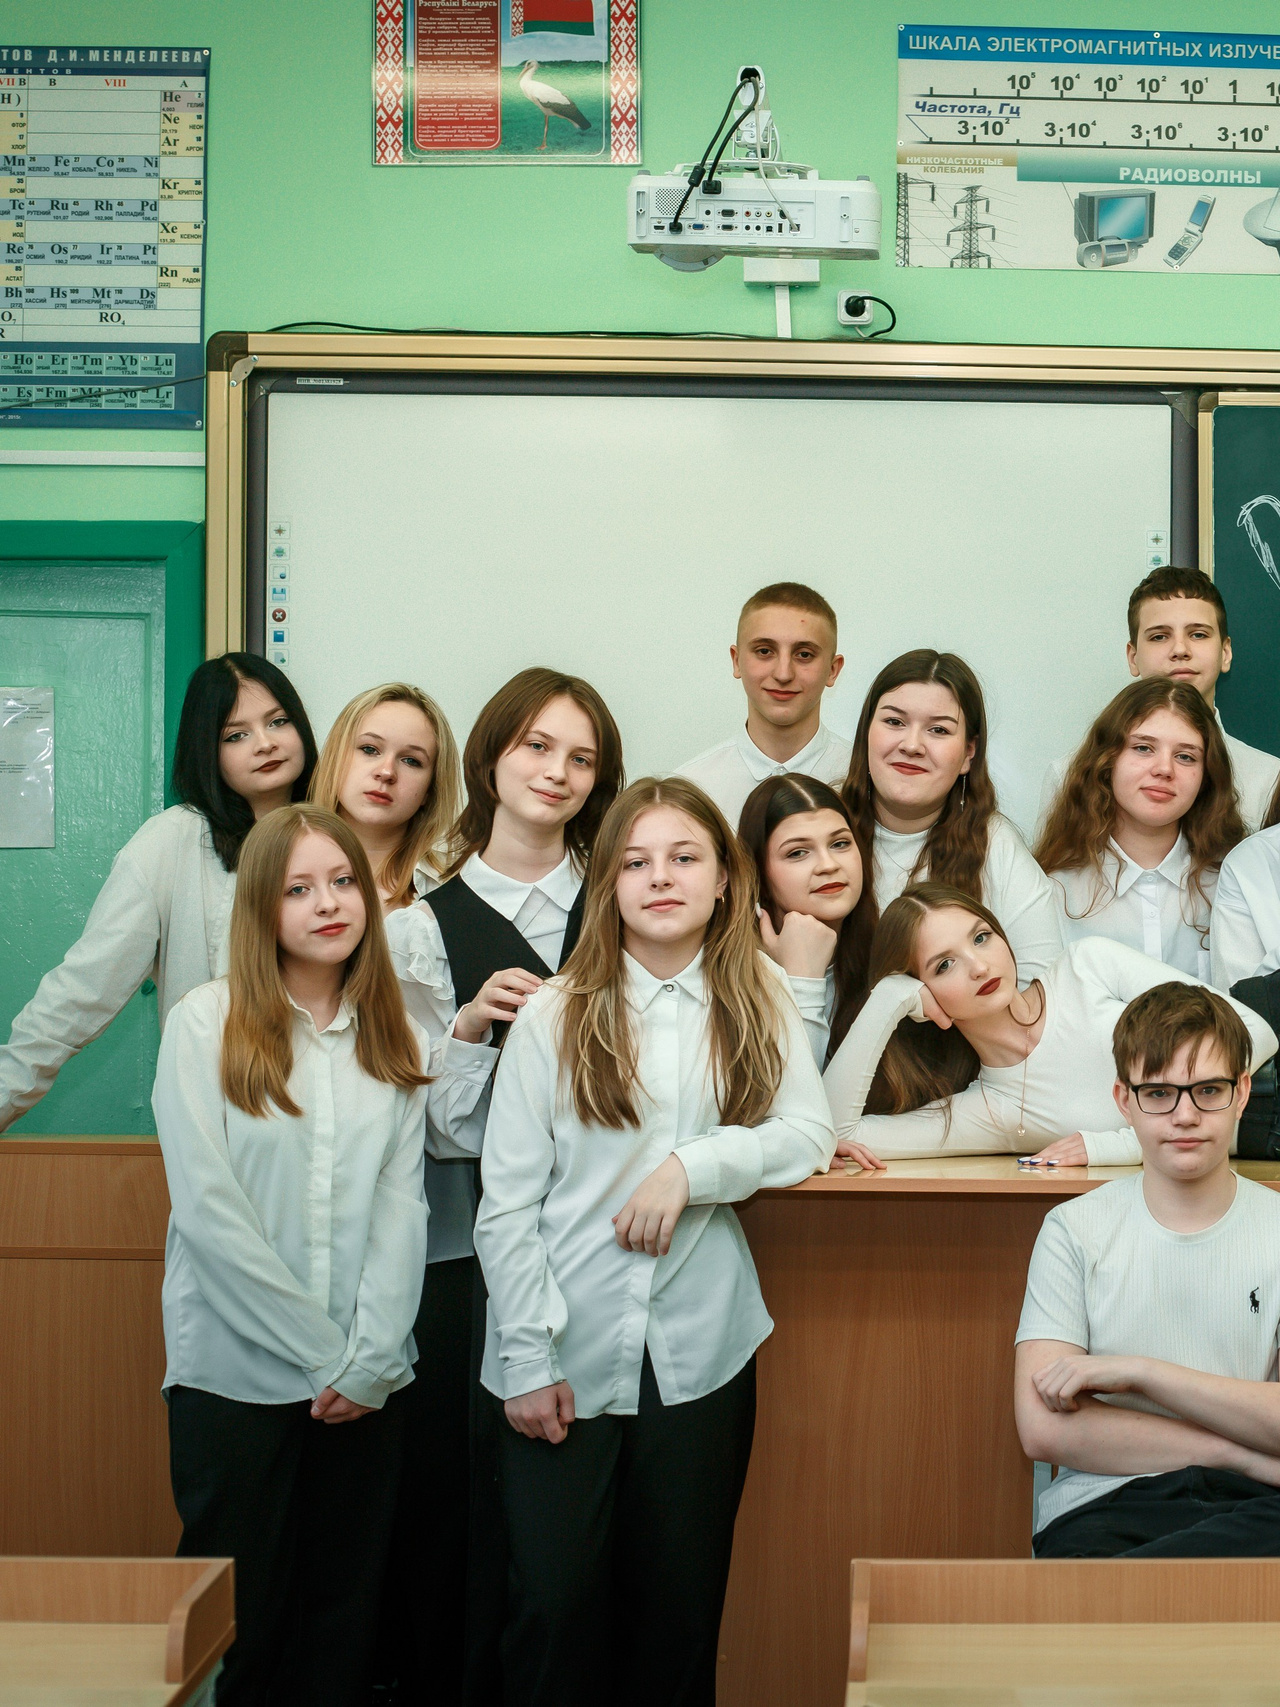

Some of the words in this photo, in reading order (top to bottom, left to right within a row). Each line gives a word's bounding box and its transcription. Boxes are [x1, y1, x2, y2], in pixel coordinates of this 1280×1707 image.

[462, 0, 498, 8] Беларусь
[909, 35, 981, 52] ШКАЛА
[987, 36, 1202, 58] ЭЛЕКТРОМАГНИТНЫХ
[104, 79, 127, 87] VIII
[1228, 79, 1238, 94] 1
[163, 91, 181, 102] He
[914, 101, 992, 116] Частота,
[999, 103, 1021, 117] Гц
[162, 113, 180, 124] Ne
[161, 136, 180, 147] Ar
[3, 156, 26, 166] Mn
[54, 156, 70, 167] Fe
[95, 156, 114, 168] Co
[143, 157, 158, 168] Ni
[906, 157, 1004, 166] НИЗКОЧАСТОТНЫЕ
[923, 166, 985, 174] КОЛЕБАНИЯ
[1118, 167, 1261, 185] РАДИОВОЛНЫ
[161, 179, 180, 190] Kr
[9, 199, 25, 210] Tc
[49, 199, 69, 211] Ru
[94, 200, 113, 211] Rh
[140, 200, 157, 211] Pd
[159, 222, 178, 234] Xe
[6, 243, 24, 254] Re
[50, 243, 69, 255] Os
[100, 244, 113, 255] Ir
[142, 244, 157, 256] Pt
[159, 267, 178, 278] Rn
[4, 287, 23, 298] Bh
[50, 287, 67, 299] Hs
[92, 288, 111, 299] Mt
[140, 288, 156, 300] Ds
[14, 354, 33, 365] Ho
[50, 354, 68, 365] Er
[80, 354, 103, 366] Tm
[119, 355, 138, 366] Yb
[154, 355, 173, 366] Lu
[16, 387, 33, 398] Es
[45, 387, 67, 398] Fm
[155, 388, 172, 399] Lr
